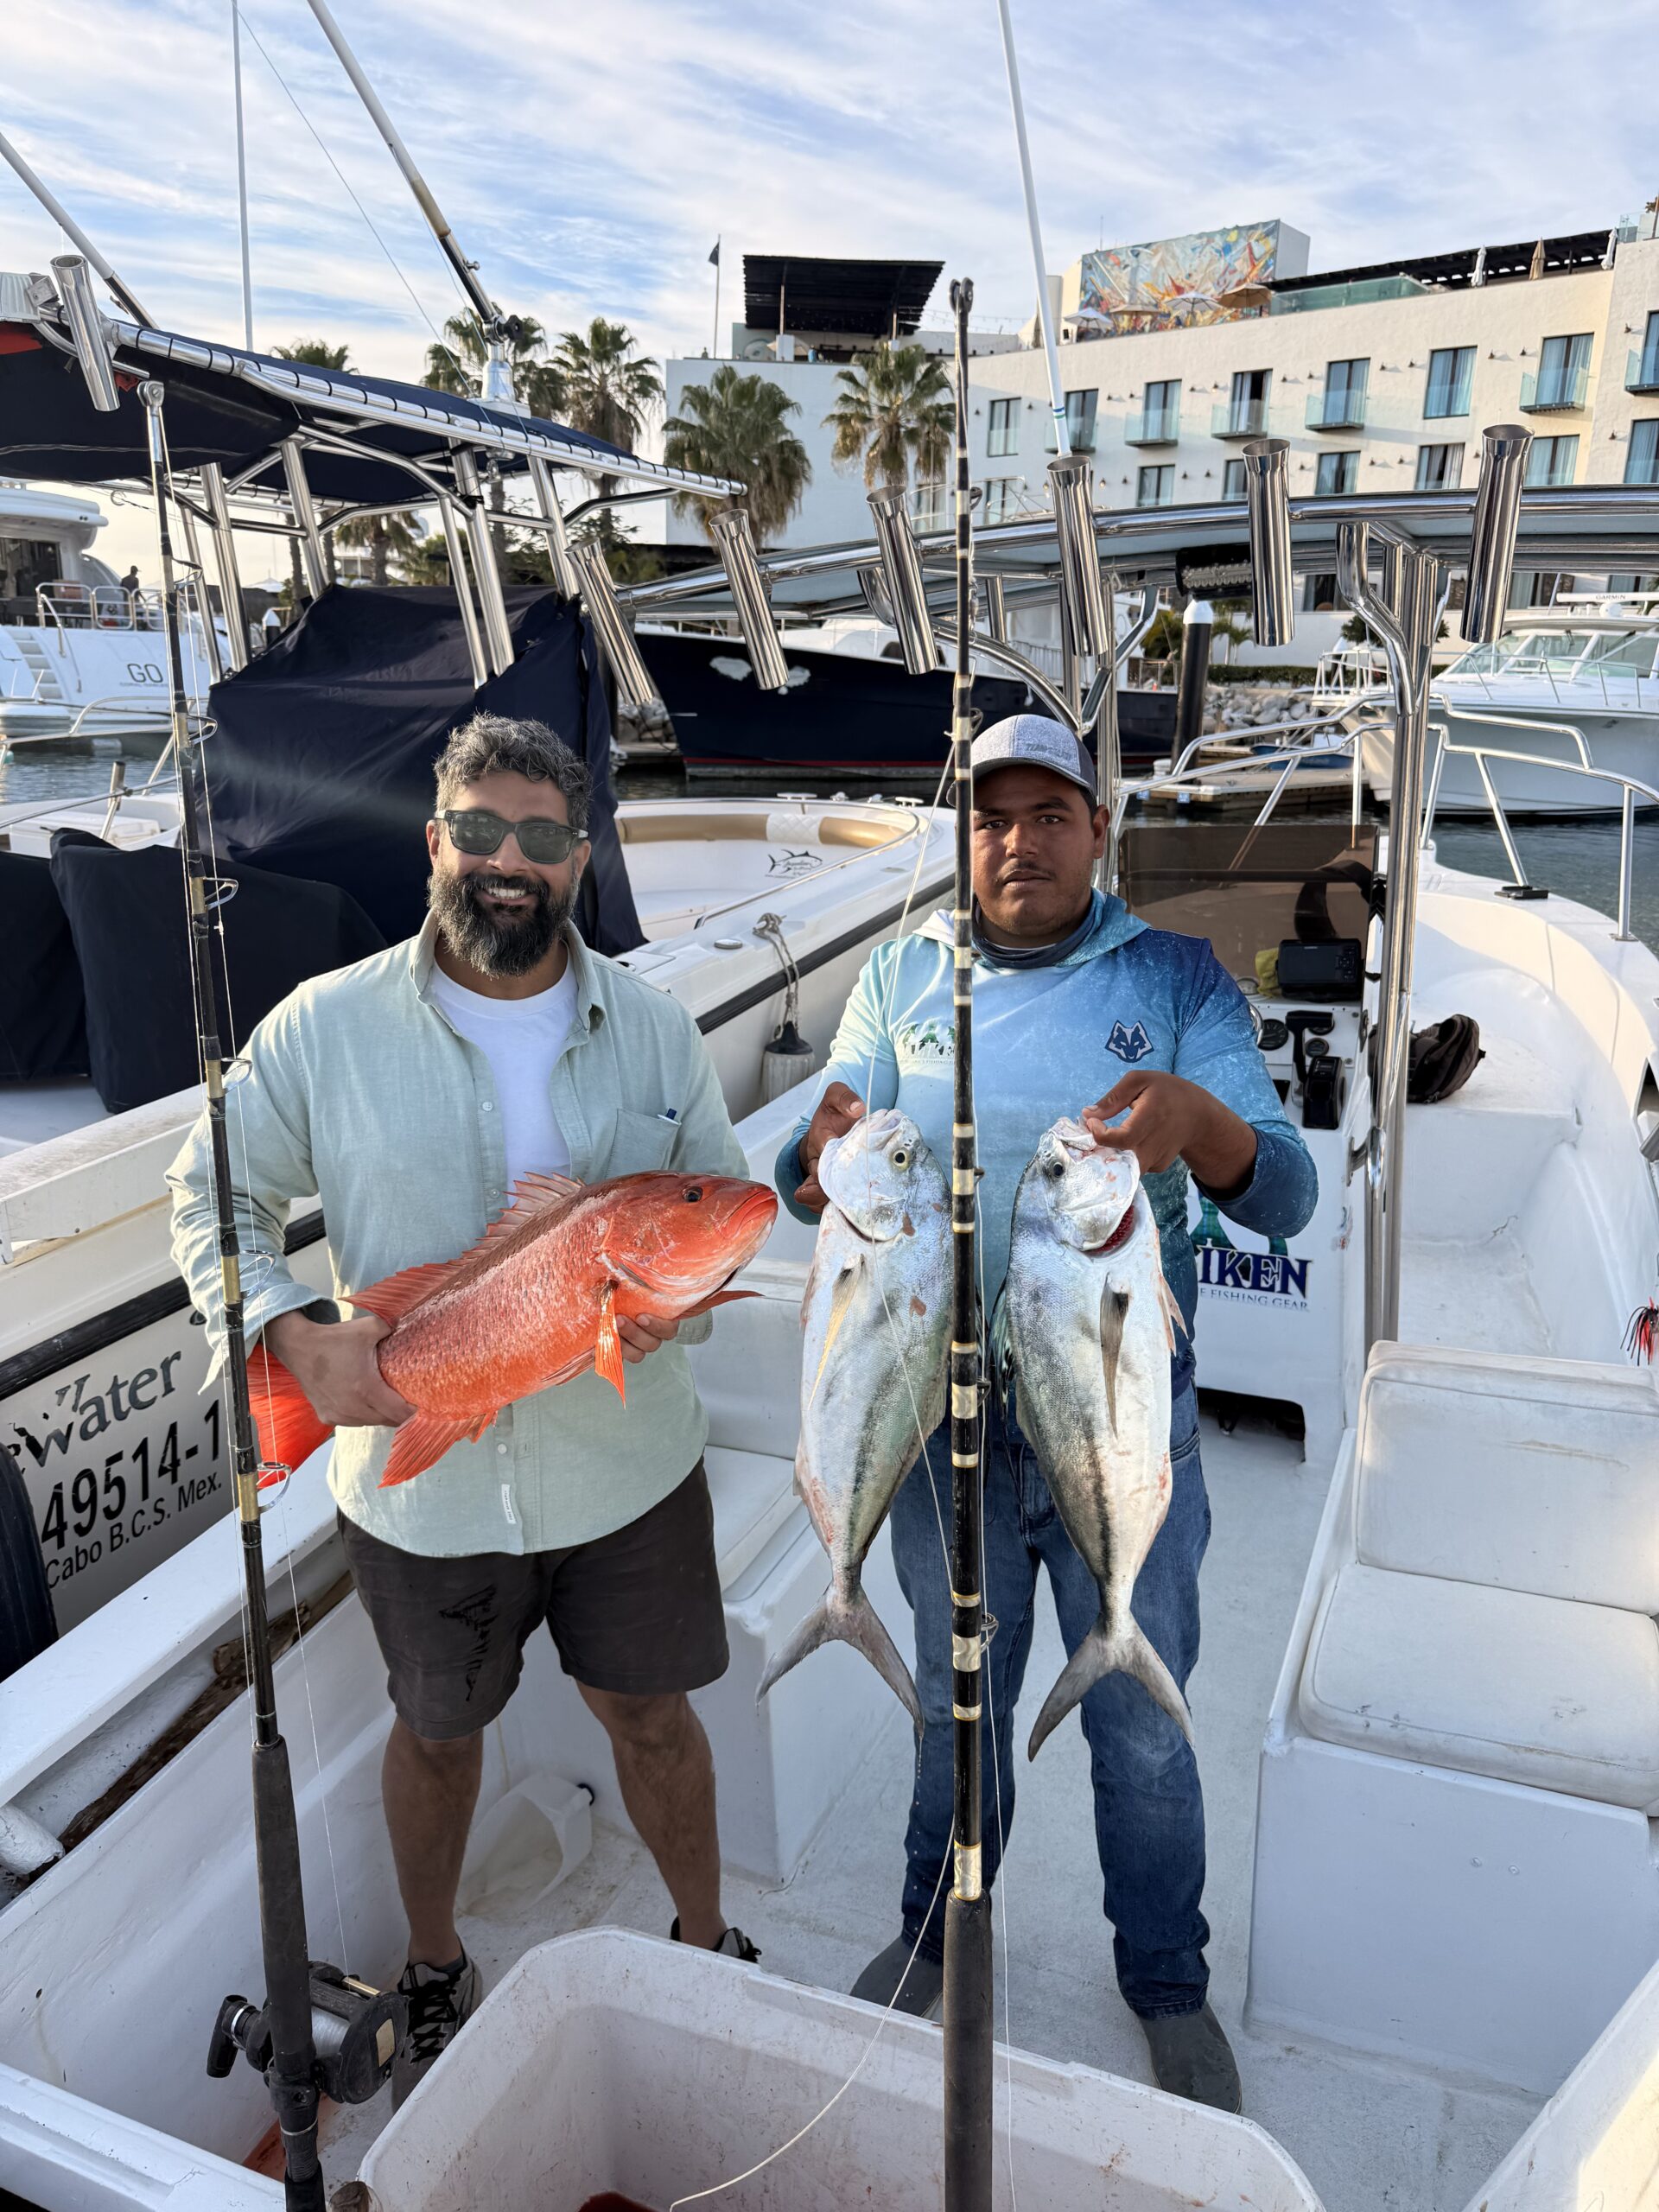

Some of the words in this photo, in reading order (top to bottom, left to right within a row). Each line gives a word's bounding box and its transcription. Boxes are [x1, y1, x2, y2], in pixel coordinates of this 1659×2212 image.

[127, 663, 164, 683] GO
[1197, 1245, 1313, 1300] IKEN
[1211, 1288, 1268, 1306] FISHING
[1272, 1297, 1311, 1313] GEAR
[41, 1399, 219, 1550] 49514-1
[46, 1541, 102, 1589] Cabo
[110, 1497, 171, 1553] B.C.S.
[178, 1472, 222, 1512] Mex.
